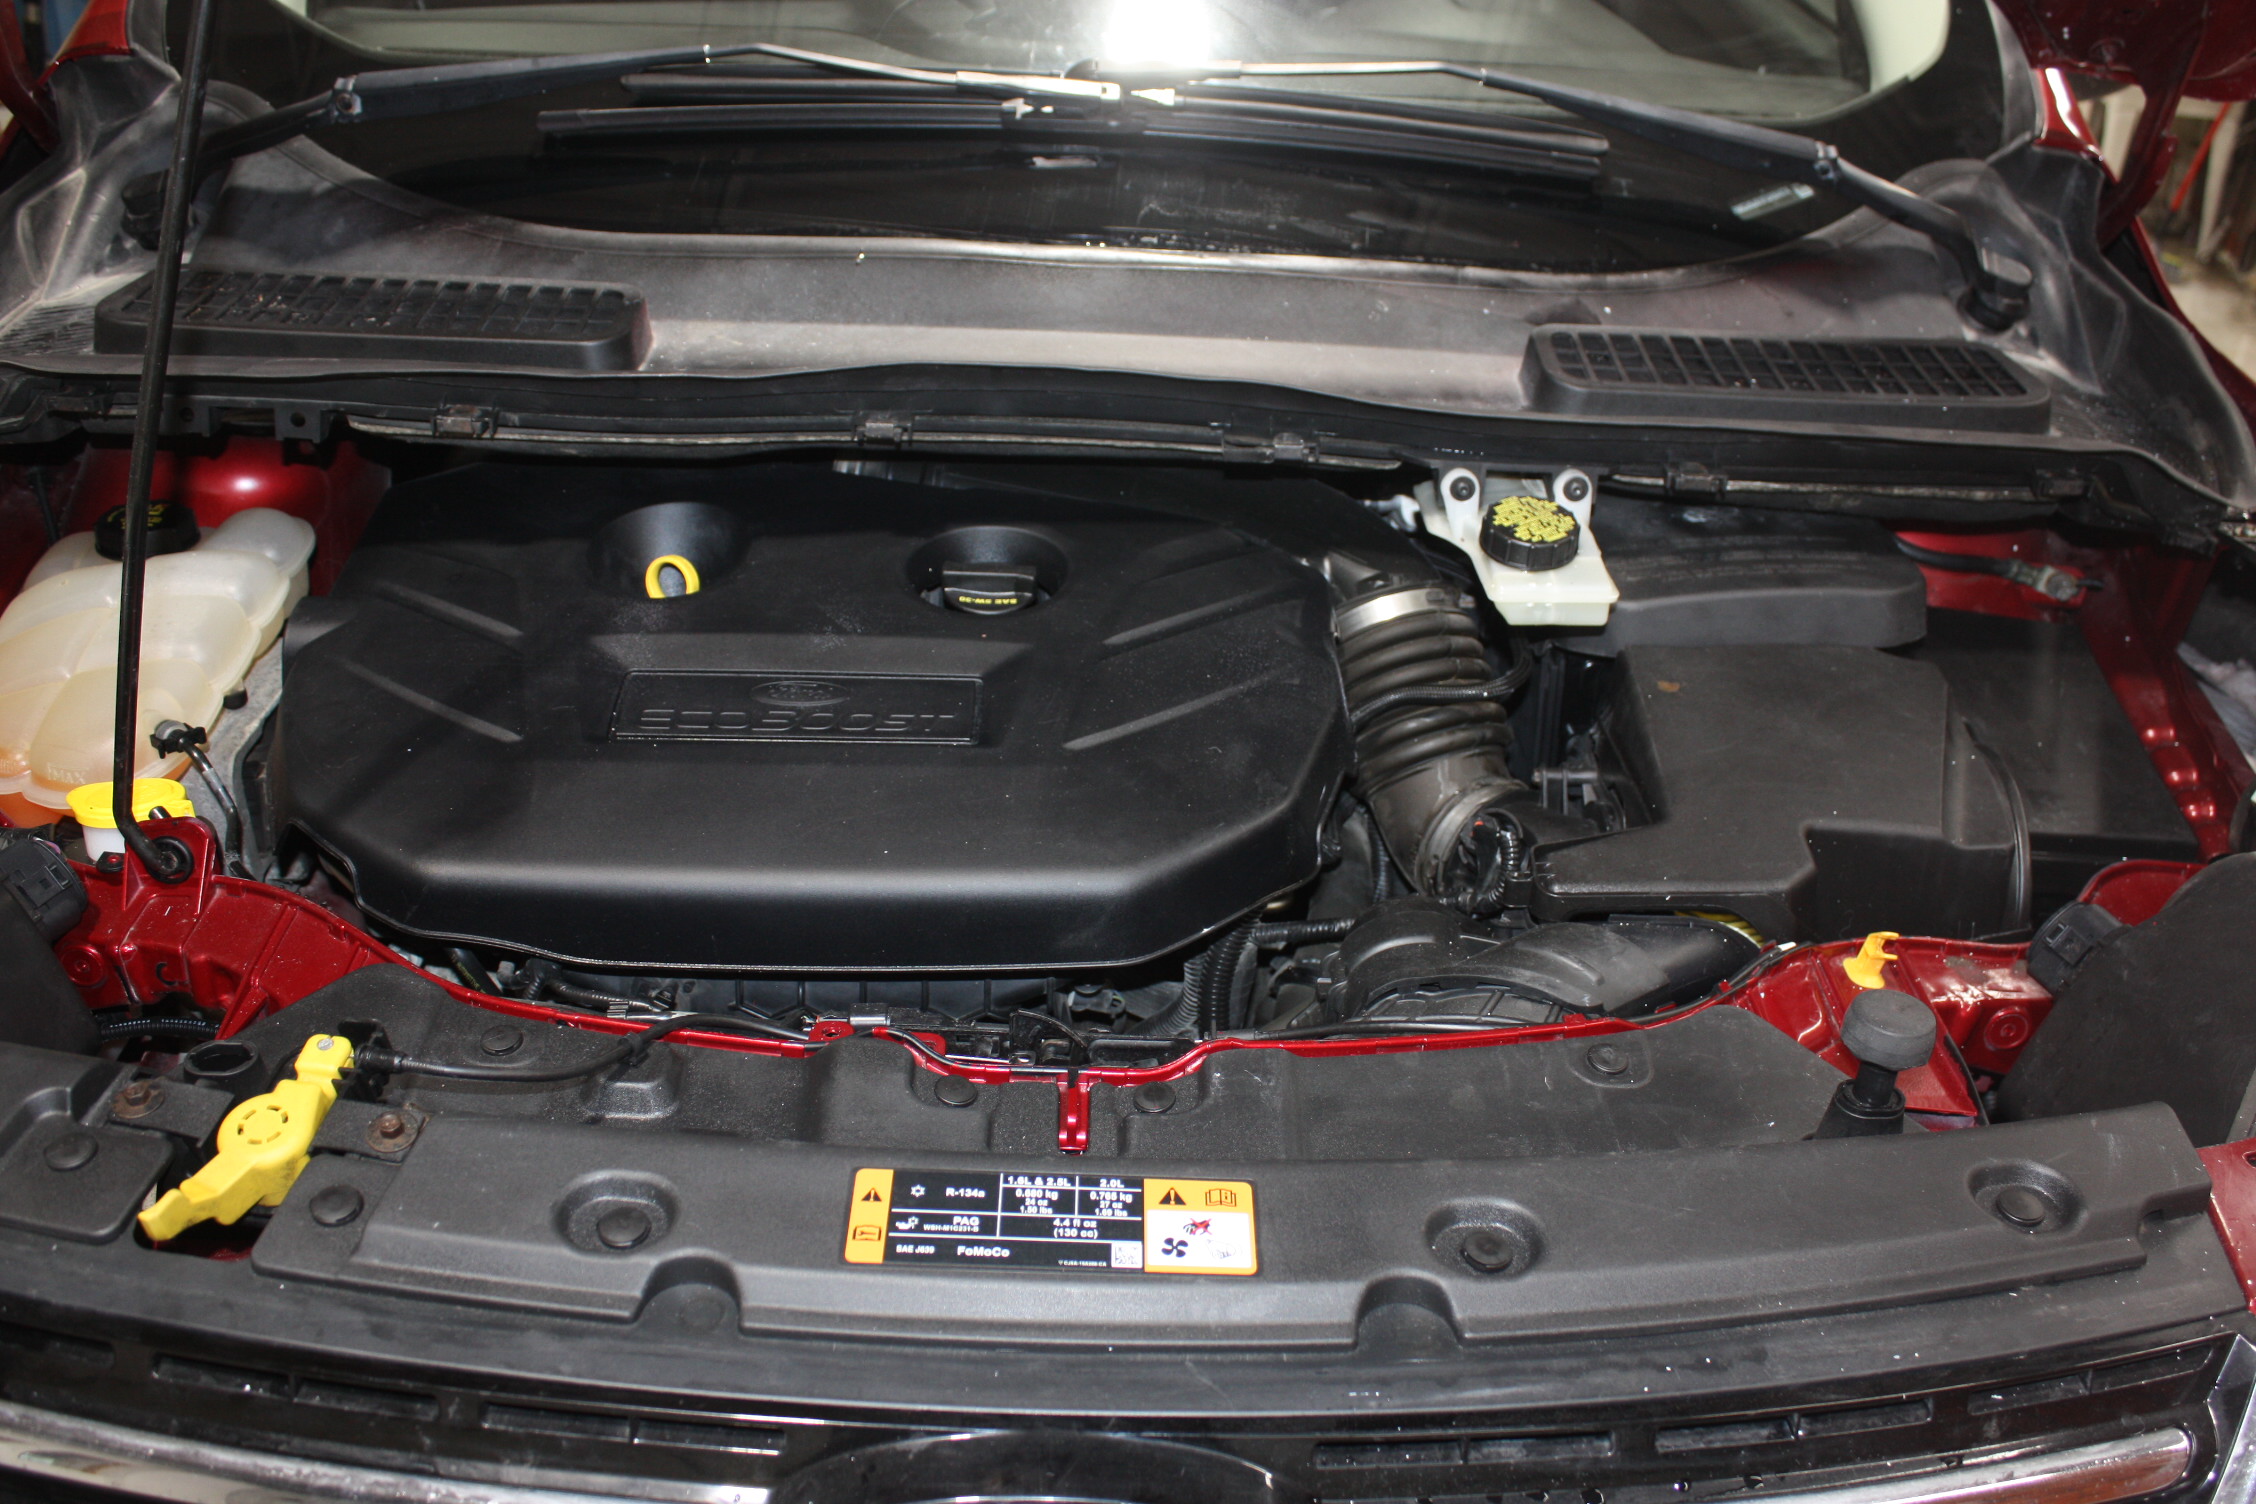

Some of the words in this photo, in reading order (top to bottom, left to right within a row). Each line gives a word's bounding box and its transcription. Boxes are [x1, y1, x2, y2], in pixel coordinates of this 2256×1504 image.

[1007, 1175, 1032, 1186] 1.6L
[1034, 1177, 1043, 1186] &
[1046, 1177, 1071, 1187] 2.5L
[1099, 1179, 1125, 1188] 2.0L
[945, 1187, 986, 1198] R-134a
[1045, 1189, 1059, 1201] kg
[1090, 1191, 1117, 1201] 0.765
[1119, 1192, 1133, 1204] kg
[1025, 1198, 1036, 1206] 24
[1020, 1205, 1037, 1213] 1.50
[1039, 1206, 1053, 1214] lbs
[1095, 1208, 1113, 1216] 1.69
[1114, 1209, 1128, 1217] lbs
[952, 1216, 980, 1226] PAG
[1053, 1218, 1070, 1227] 4.4
[1073, 1219, 1081, 1227] fl
[1083, 1220, 1097, 1228] oz
[1053, 1228, 1078, 1239] (130
[1080, 1229, 1099, 1240] cc)
[896, 1244, 914, 1253] SAE
[957, 1246, 1011, 1258] FoMoCo
